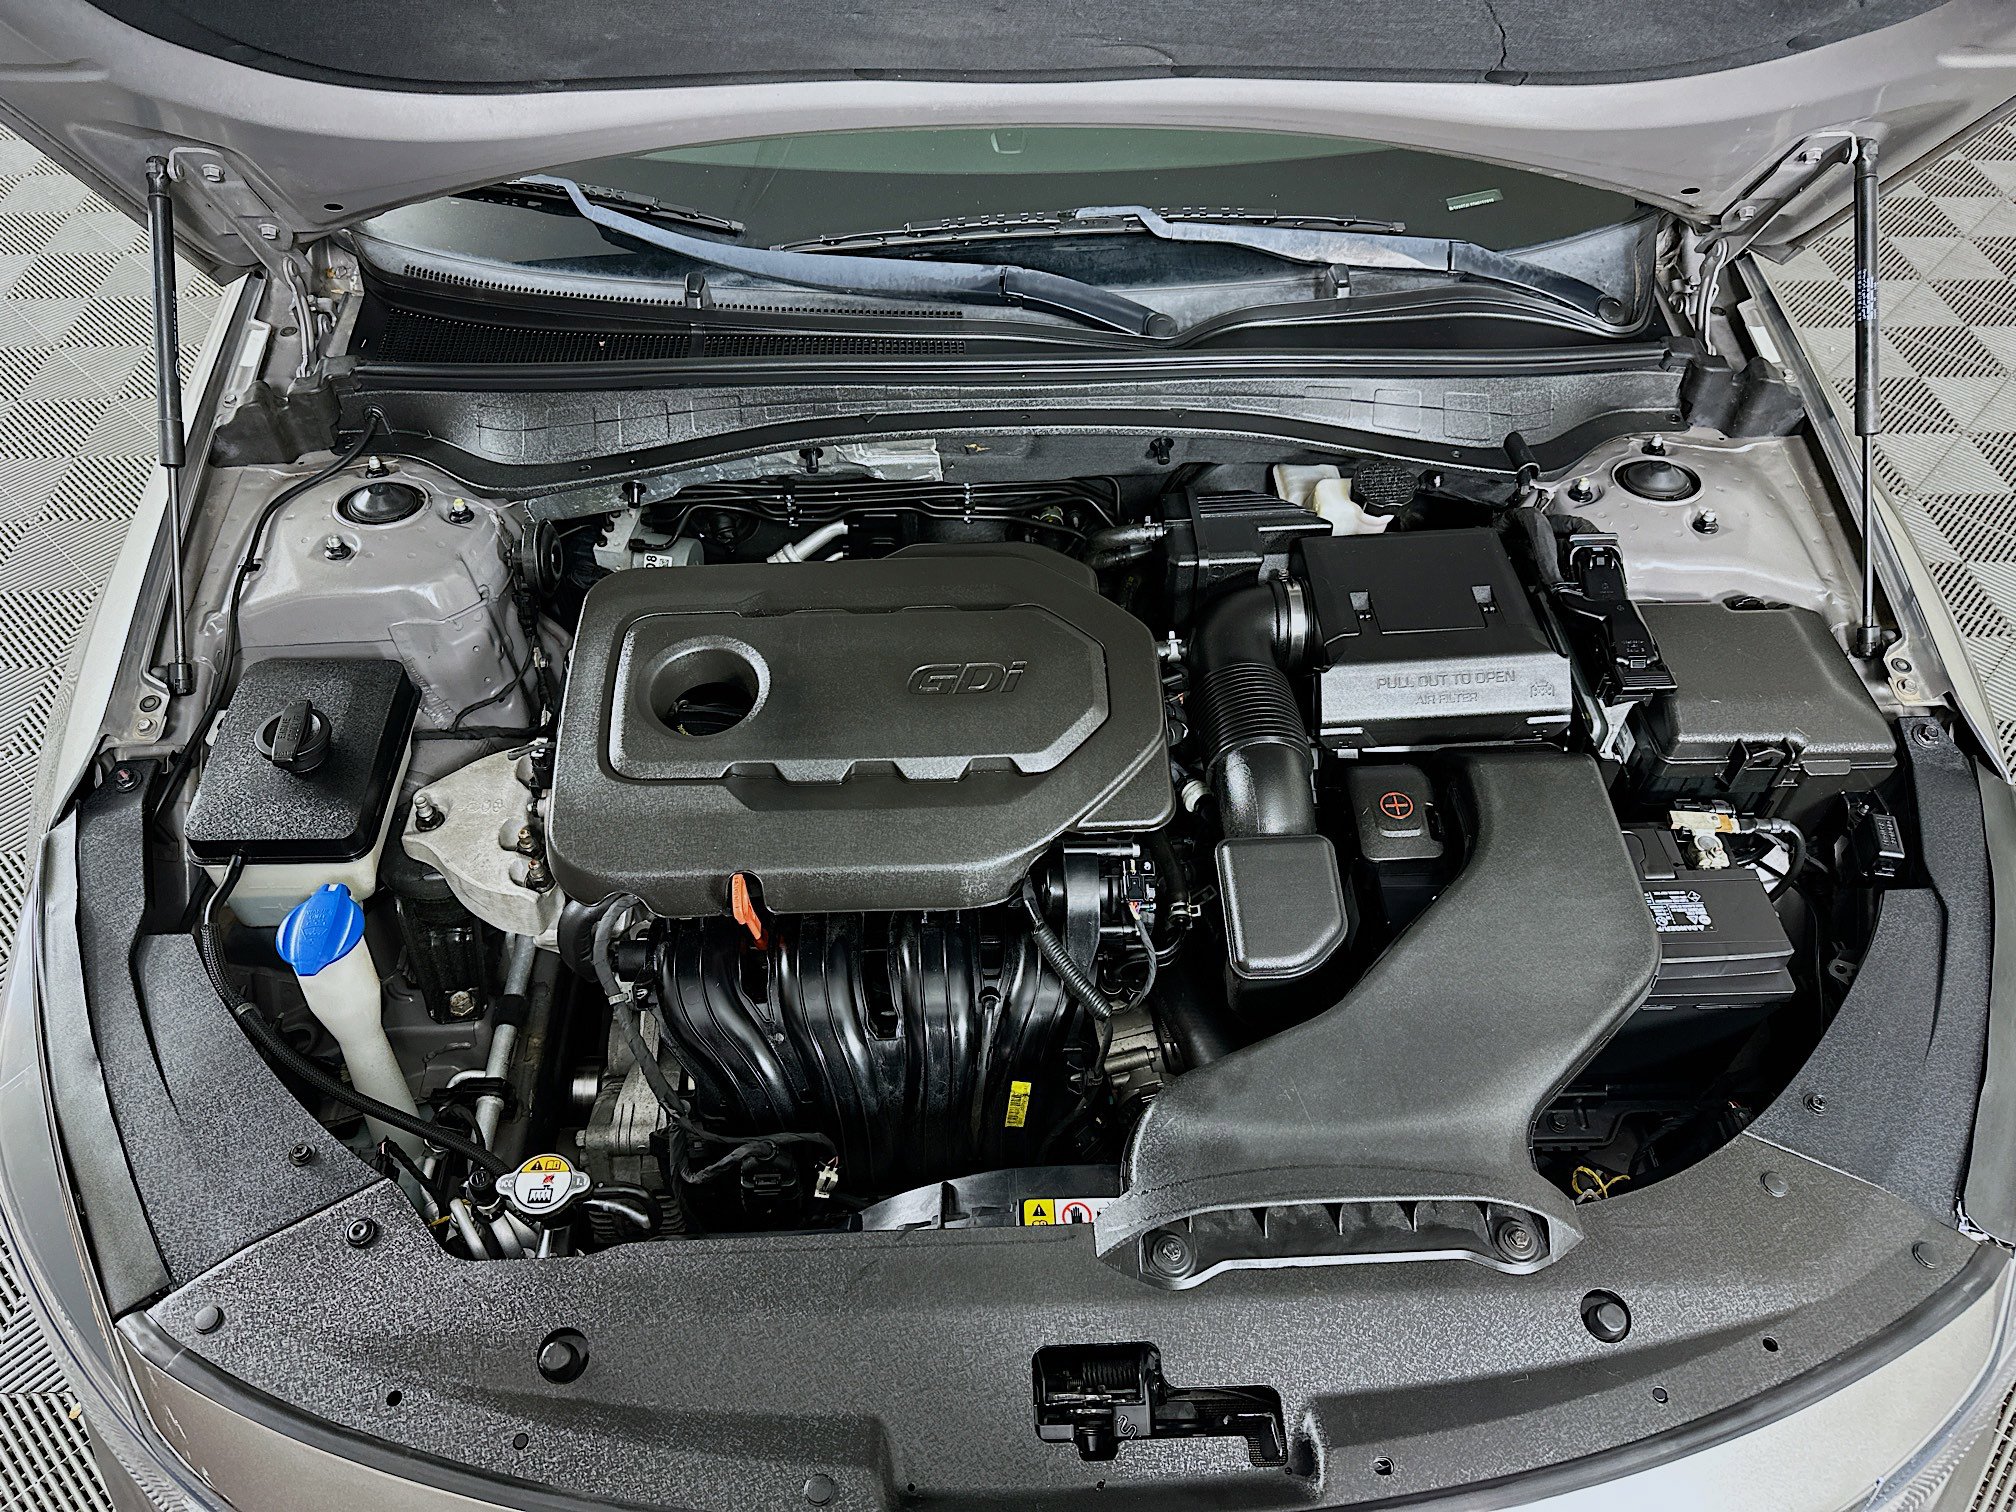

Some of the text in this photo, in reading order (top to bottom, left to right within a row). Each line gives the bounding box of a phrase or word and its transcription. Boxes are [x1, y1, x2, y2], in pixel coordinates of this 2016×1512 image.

[906, 660, 1028, 695] GDi
[1376, 670, 1516, 690] PULL OUT TO OPEN
[1415, 691, 1478, 706] AIR FILTER
